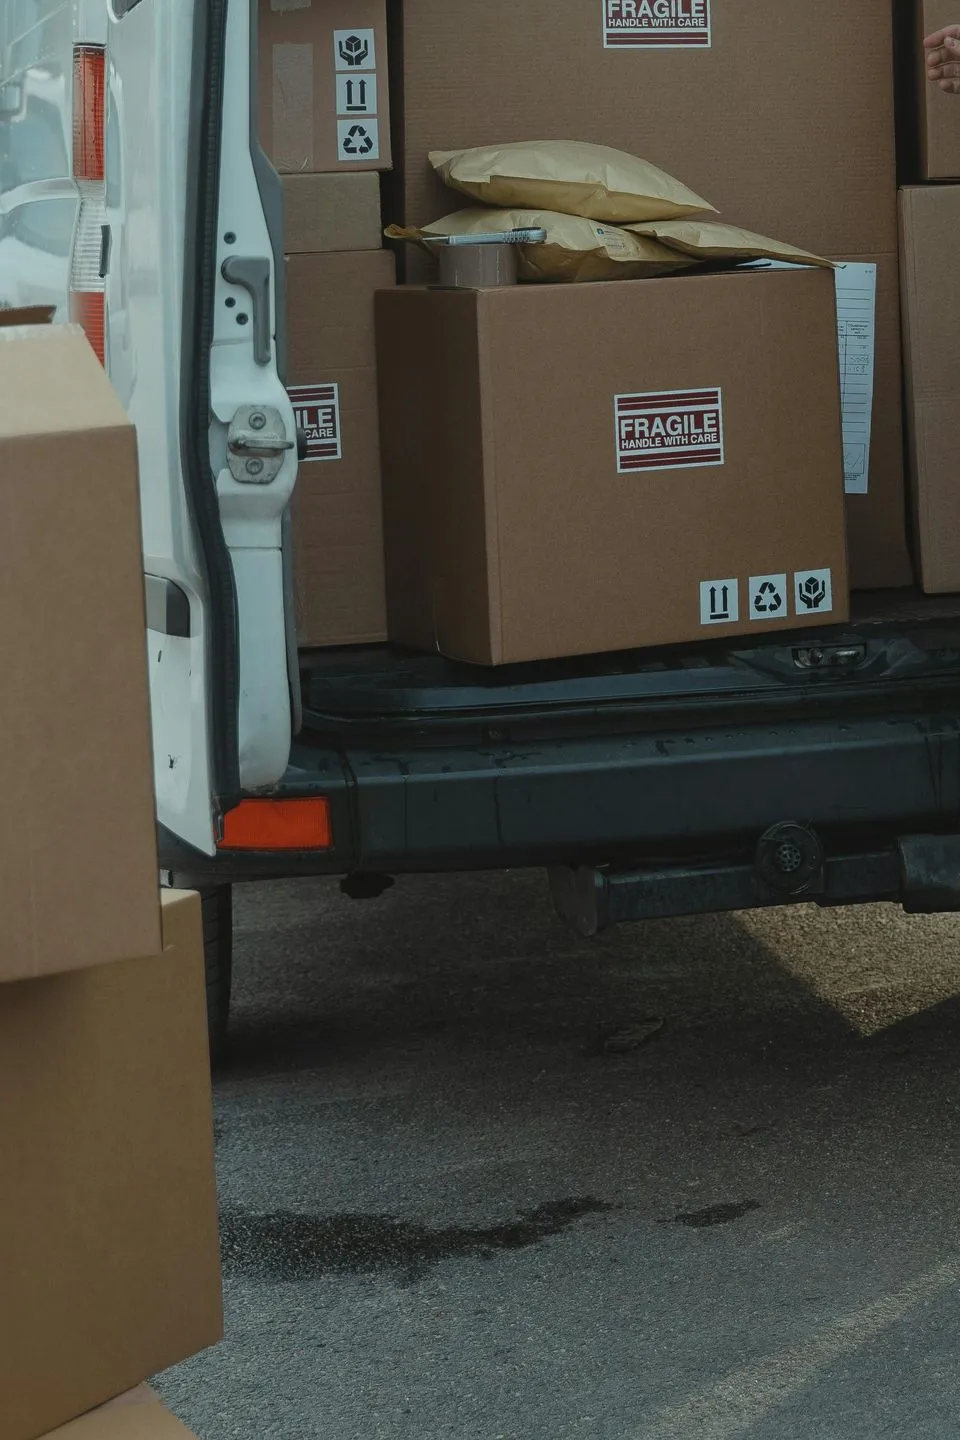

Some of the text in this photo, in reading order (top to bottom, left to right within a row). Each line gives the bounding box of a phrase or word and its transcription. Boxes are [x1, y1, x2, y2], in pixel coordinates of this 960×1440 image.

[607, 0, 705, 18] FRAGILE
[608, 18, 705, 27] HANDLE WITH CARE
[304, 427, 334, 439] CARE
[620, 412, 718, 439] FRAGILE
[621, 433, 718, 449] HANDLE WITH CARE
